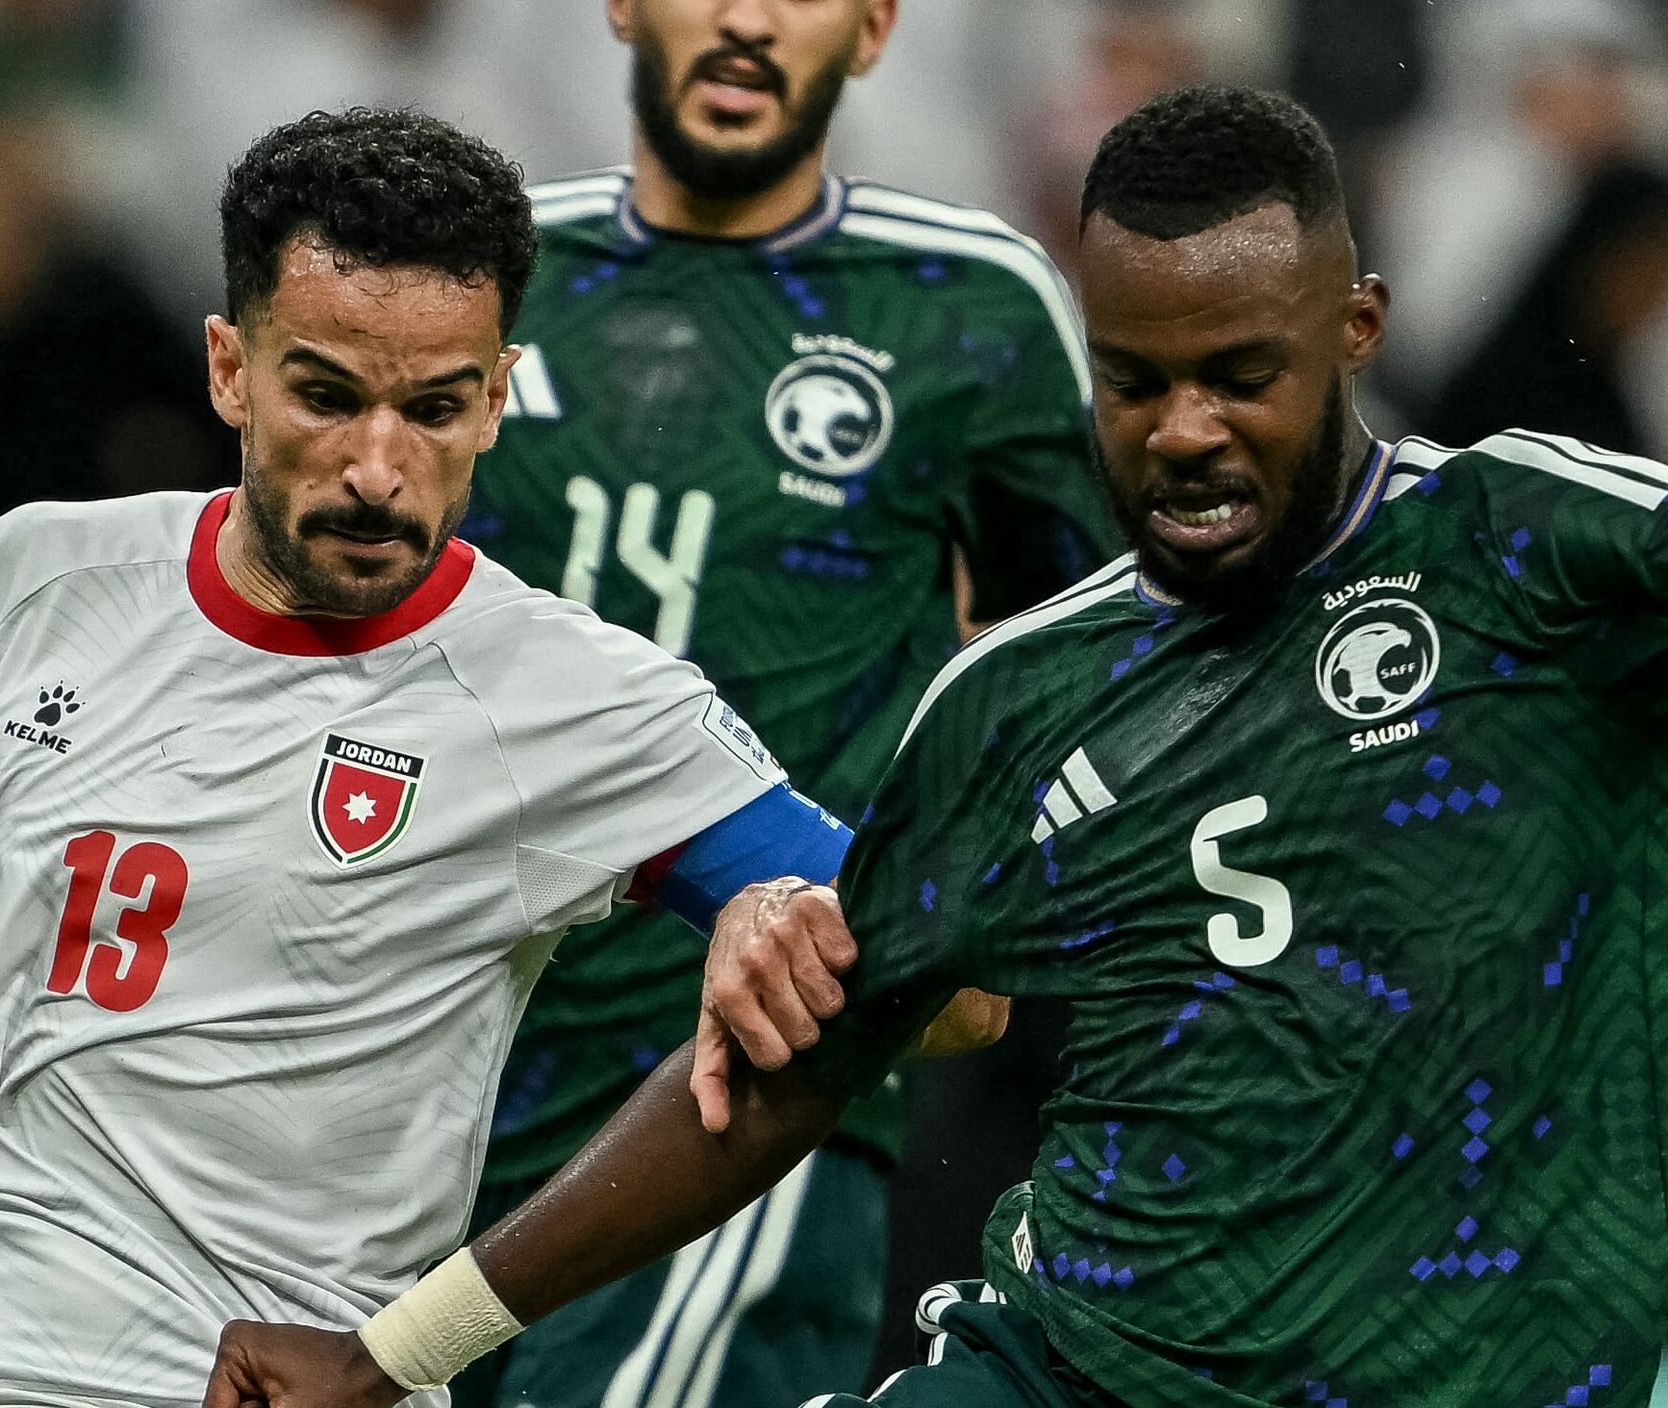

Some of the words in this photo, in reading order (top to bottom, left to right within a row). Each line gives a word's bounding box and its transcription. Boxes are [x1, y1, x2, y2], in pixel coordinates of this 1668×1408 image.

[560, 475, 716, 658] 14
[1322, 571, 1422, 611] السعودية
[1380, 662, 1417, 679] SAFF
[3, 720, 72, 754] KELME
[1348, 720, 1419, 752] SAUDI
[336, 741, 412, 773] JORDAN
[1190, 795, 1294, 966] 5
[46, 829, 189, 1013] 13
